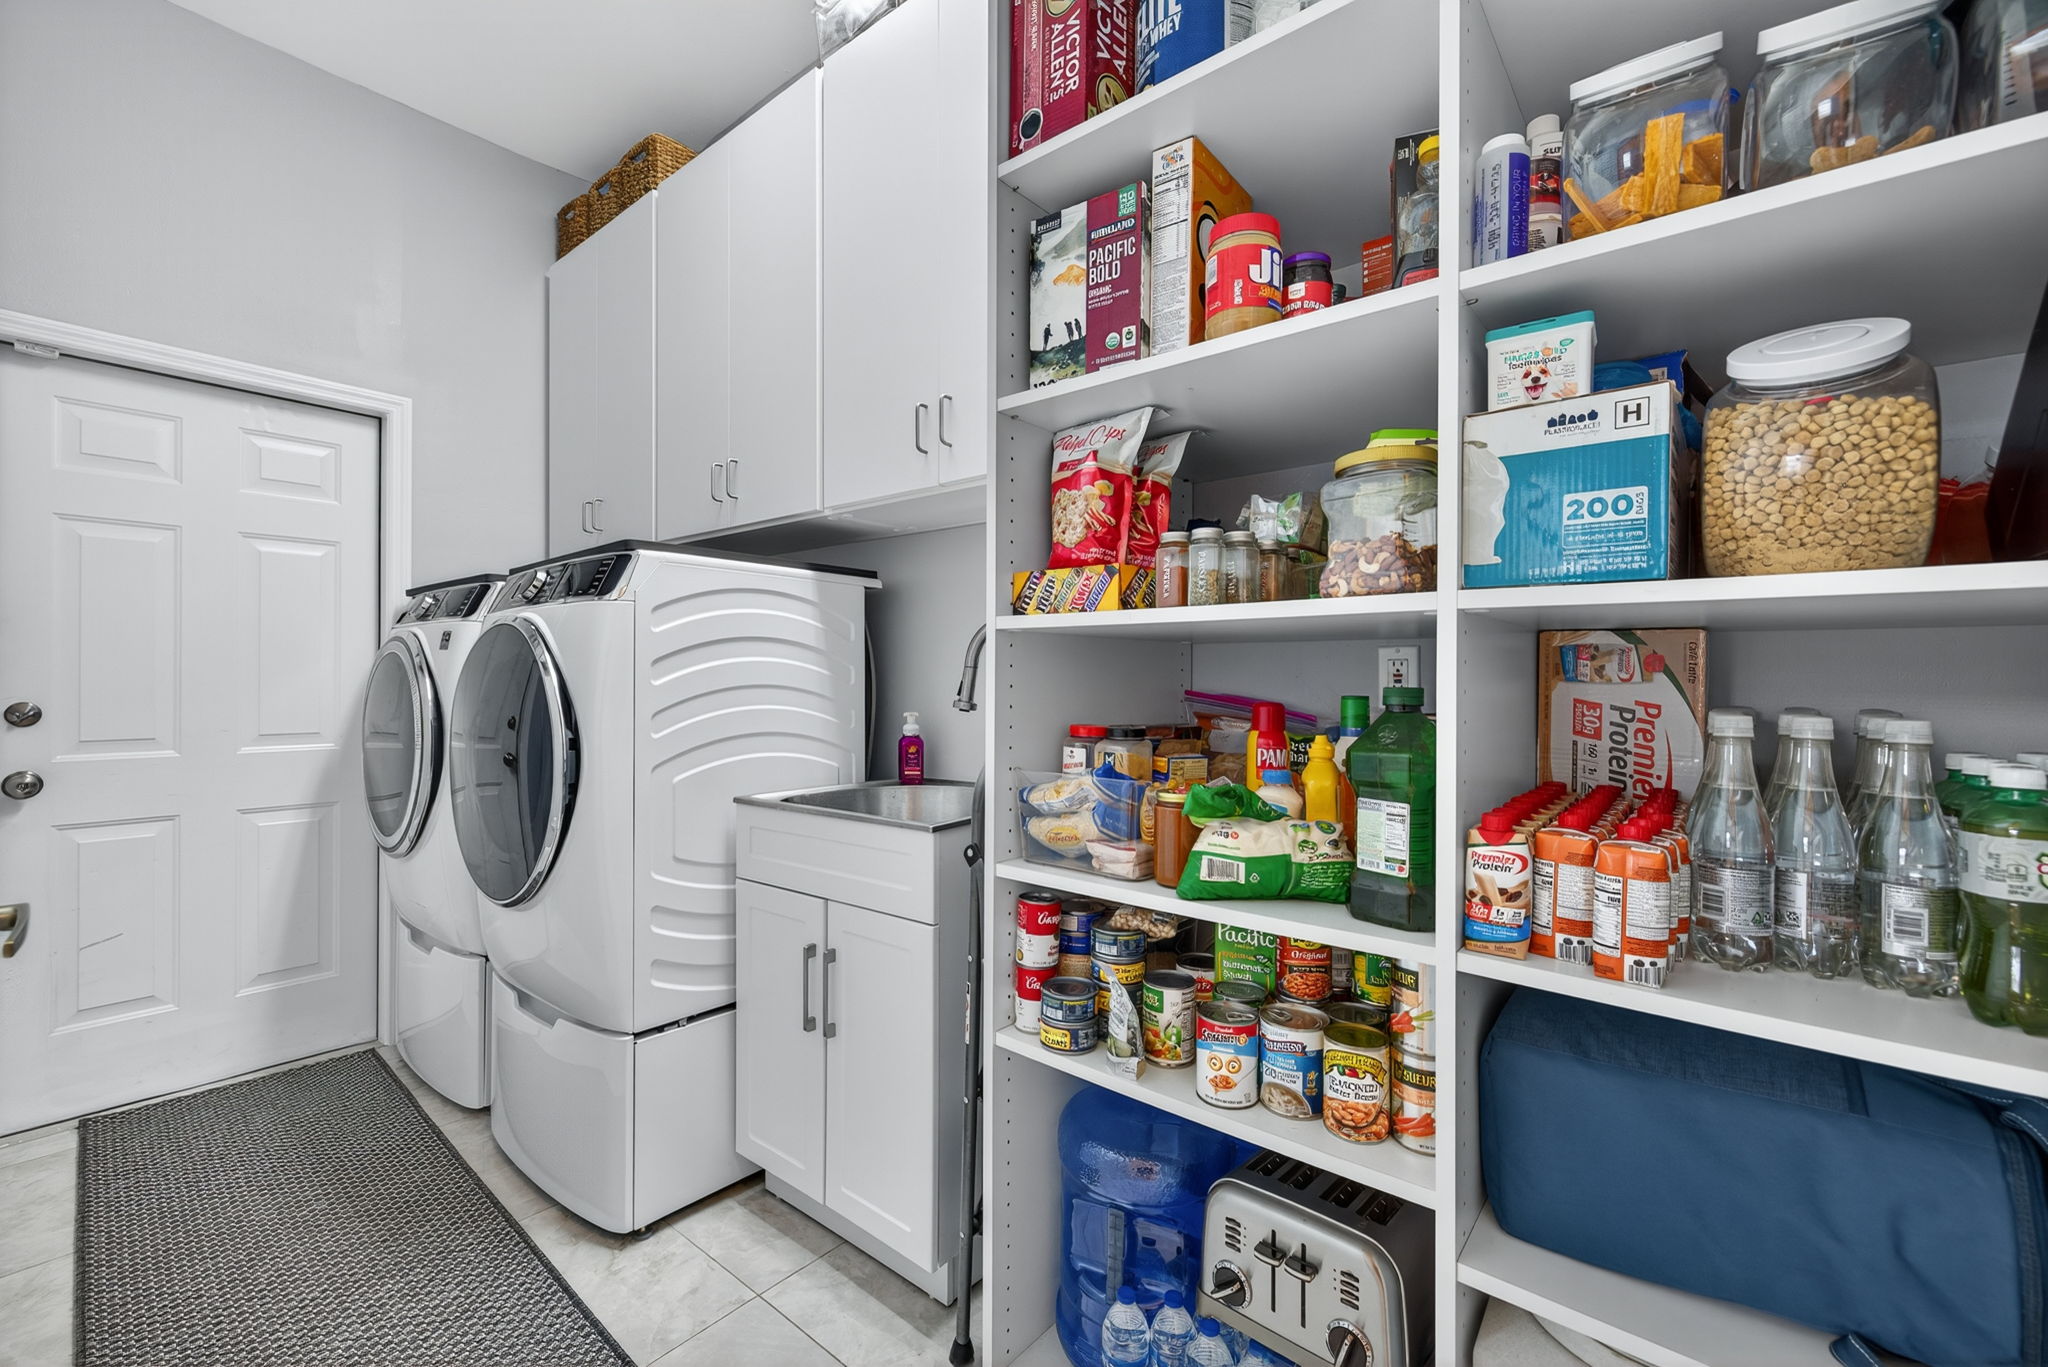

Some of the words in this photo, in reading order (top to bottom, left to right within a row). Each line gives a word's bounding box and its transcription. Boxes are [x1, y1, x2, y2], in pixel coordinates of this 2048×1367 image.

[1150, 11, 1182, 46] WHEY
[1050, 23, 1066, 103] ALLEN'S
[1064, 8, 1081, 94] VICTOR
[1089, 236, 1137, 268] PACIFIC
[1089, 260, 1121, 286] BOLD
[1623, 402, 1642, 423] H
[1566, 493, 1634, 521] 200
[1582, 702, 1600, 735] 30g
[1257, 748, 1287, 768] PAM
[1608, 704, 1636, 792] Protein
[1632, 700, 1662, 800] Premier
[1472, 859, 1513, 873] Protein
[1217, 922, 1277, 948] Pacific
